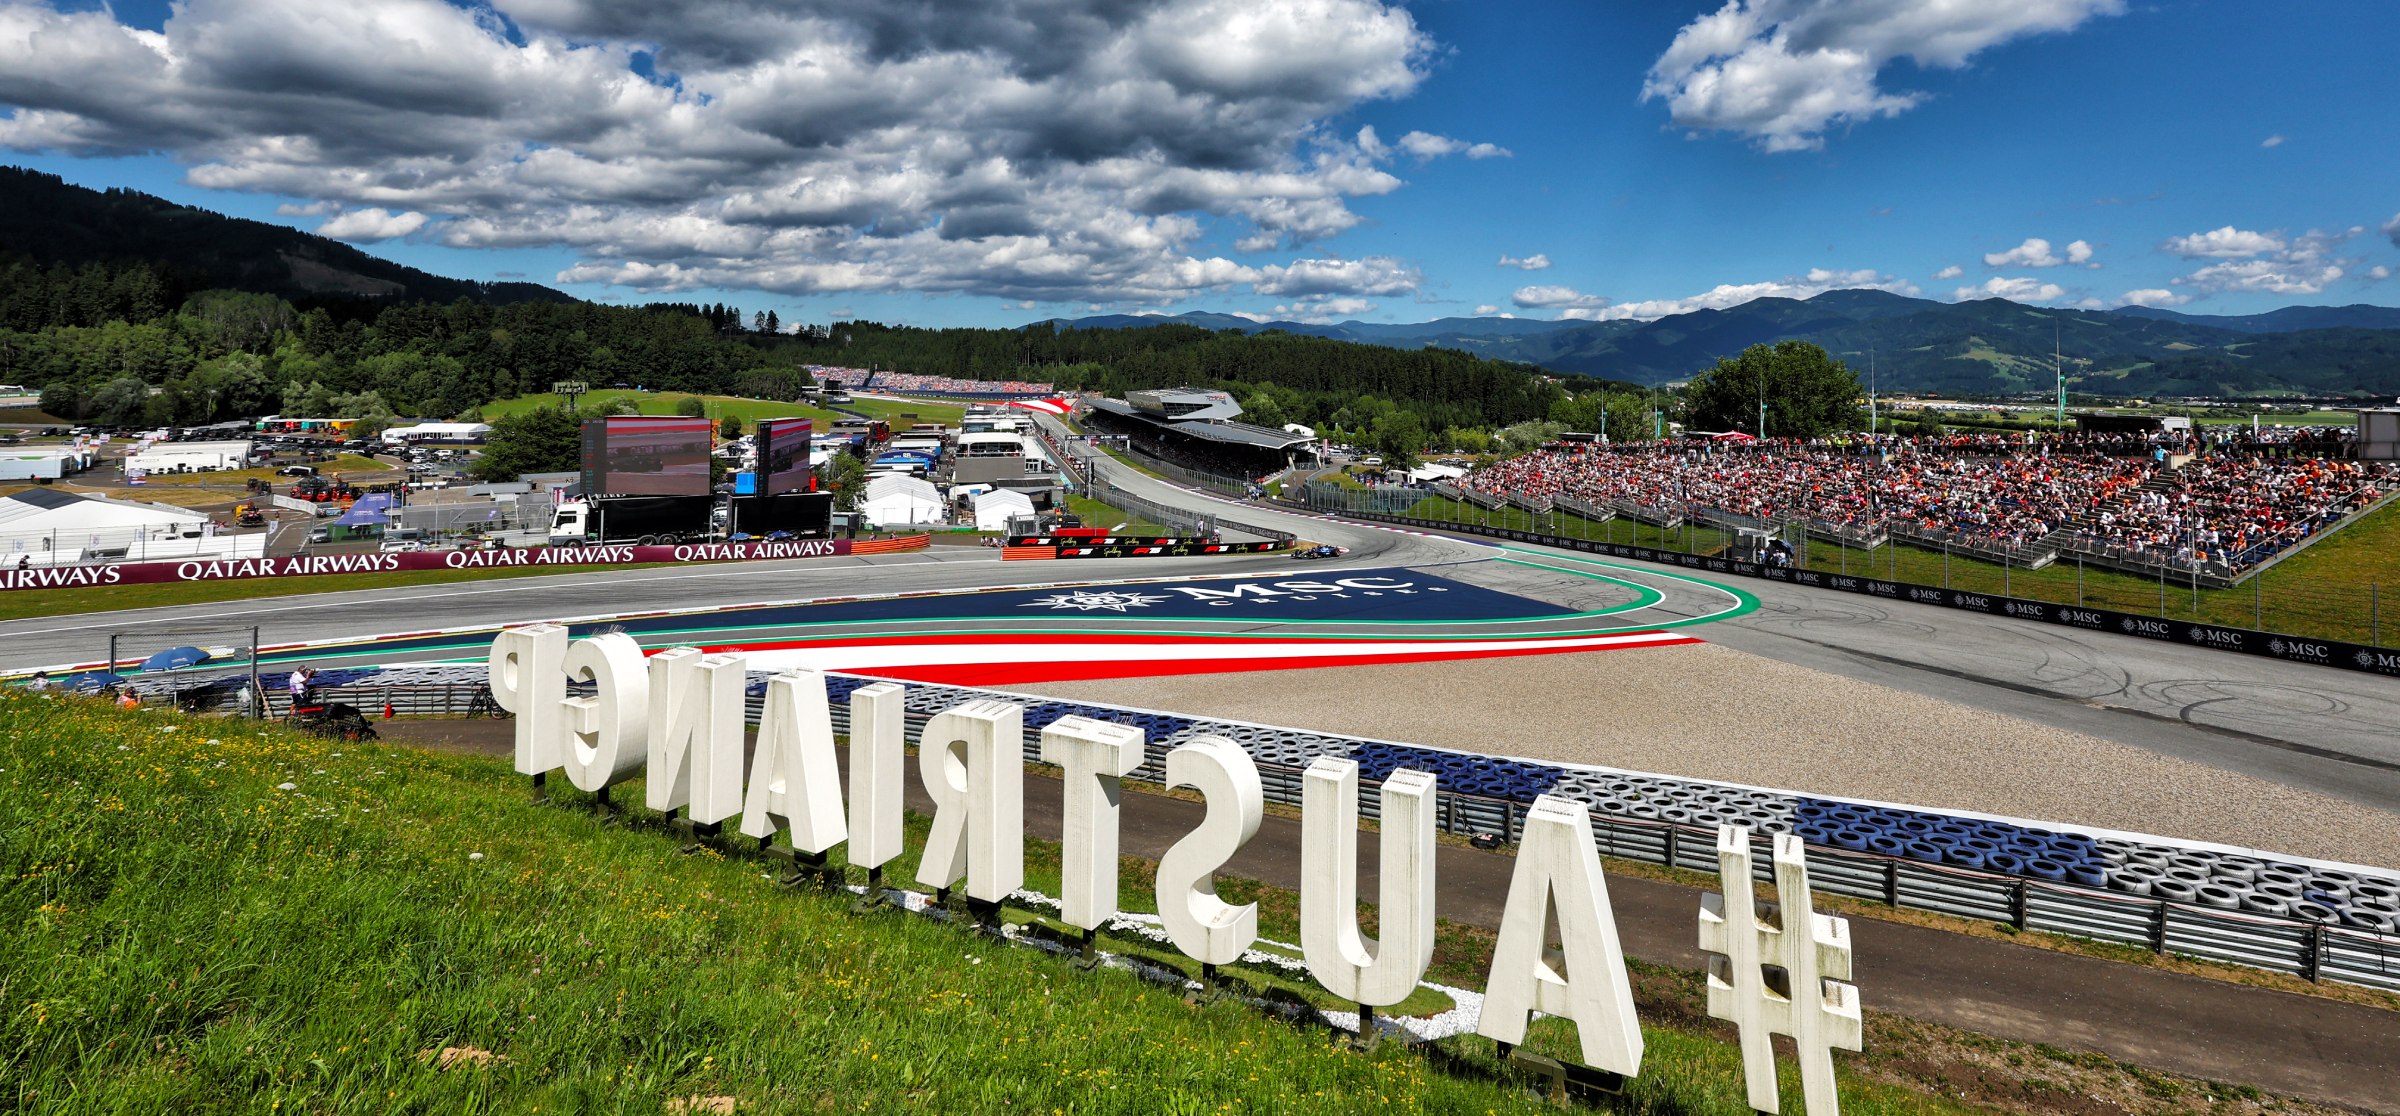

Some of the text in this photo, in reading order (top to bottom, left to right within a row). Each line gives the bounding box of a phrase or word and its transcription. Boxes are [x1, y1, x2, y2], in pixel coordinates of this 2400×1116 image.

[674, 541, 835, 562] QATAR AIRWAYS
[445, 547, 634, 569] QATAR AIRWAYS
[1686, 556, 1699, 564] MSC
[177, 553, 399, 580] QATAR AIRWAYS
[1712, 560, 1726, 569] MSC
[1740, 564, 1755, 572] MSC
[1771, 568, 1786, 577] MSC
[1803, 572, 1819, 582] MSC
[1838, 577, 1857, 587] MSC
[1877, 582, 1896, 593] MSC
[1163, 576, 1414, 601] MSC
[1920, 589, 1941, 600] MSC
[1965, 595, 1989, 607] MSC
[2018, 603, 2043, 615] MSC
[2073, 610, 2101, 624] MSC
[2137, 619, 2169, 634] MSC
[2206, 629, 2242, 645] MSC
[2287, 641, 2329, 658] MSC
